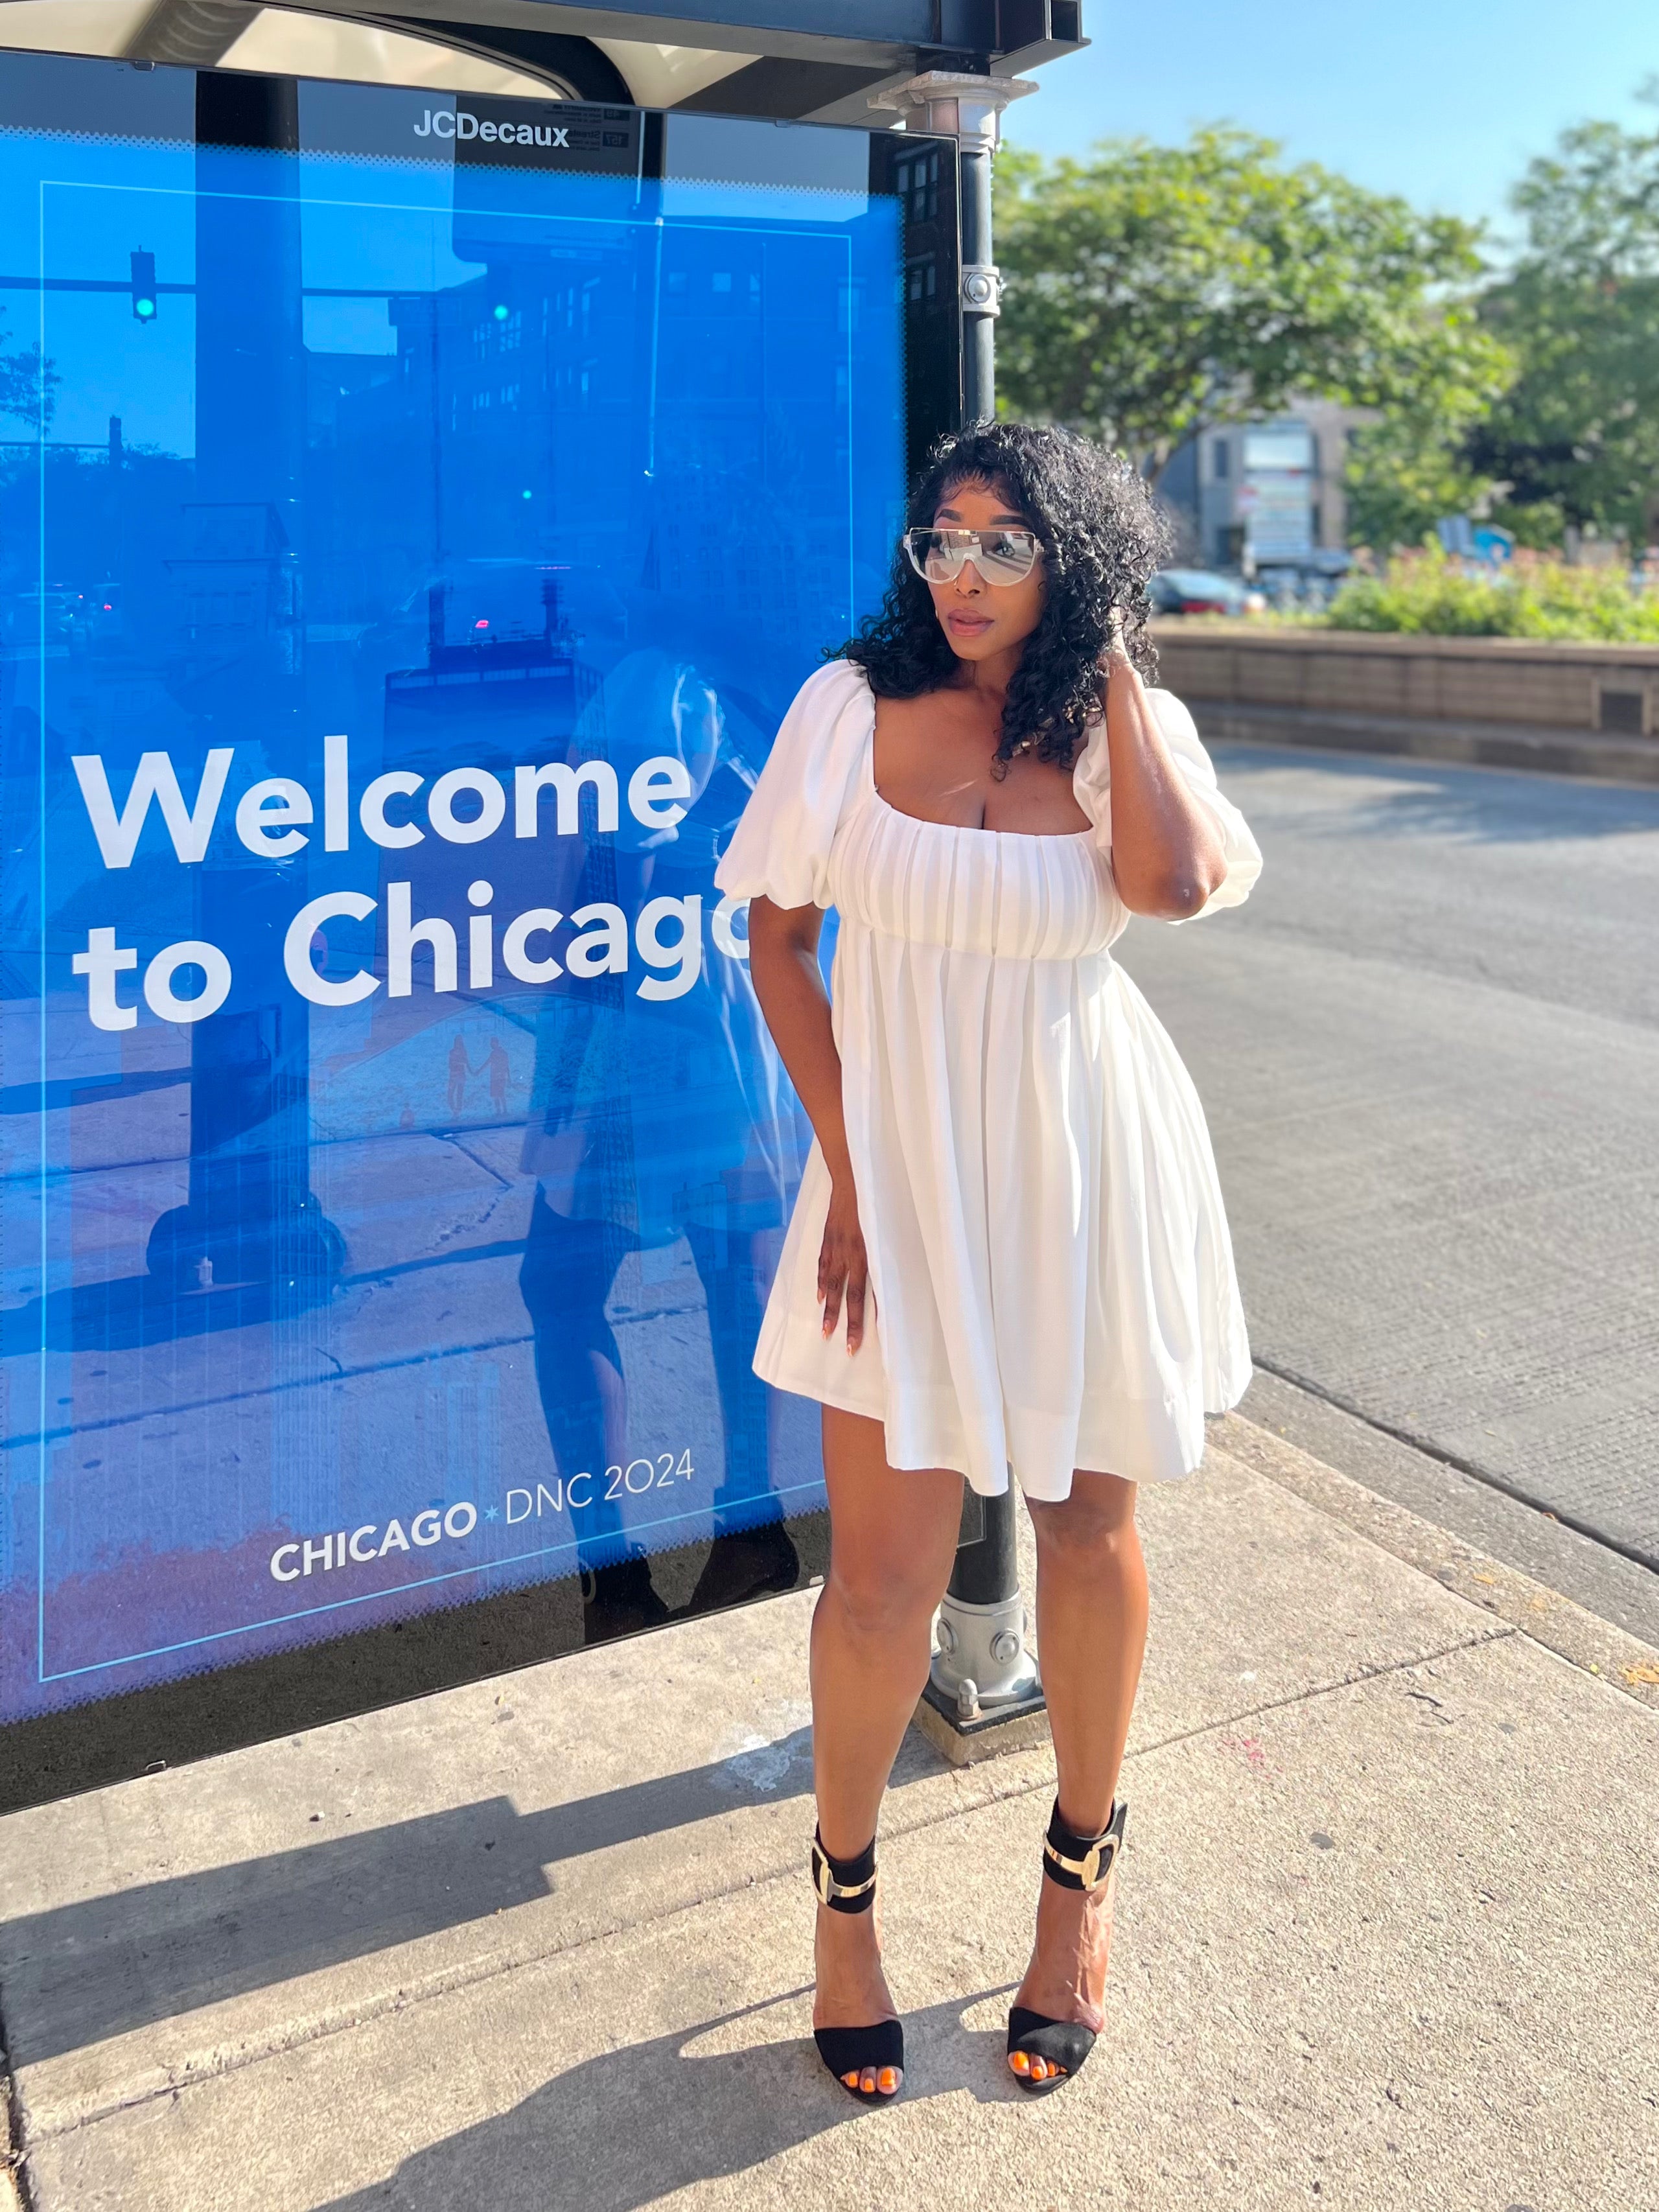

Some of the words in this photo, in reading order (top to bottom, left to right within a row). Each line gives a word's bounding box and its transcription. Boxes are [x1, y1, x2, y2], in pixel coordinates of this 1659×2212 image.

[413, 110, 570, 148] JCDecaux
[73, 736, 691, 868] Welcome
[72, 927, 232, 1031] to
[270, 1501, 478, 1582] CHICAGO
[505, 1473, 592, 1524] DNC
[604, 1448, 695, 1500] 2024
